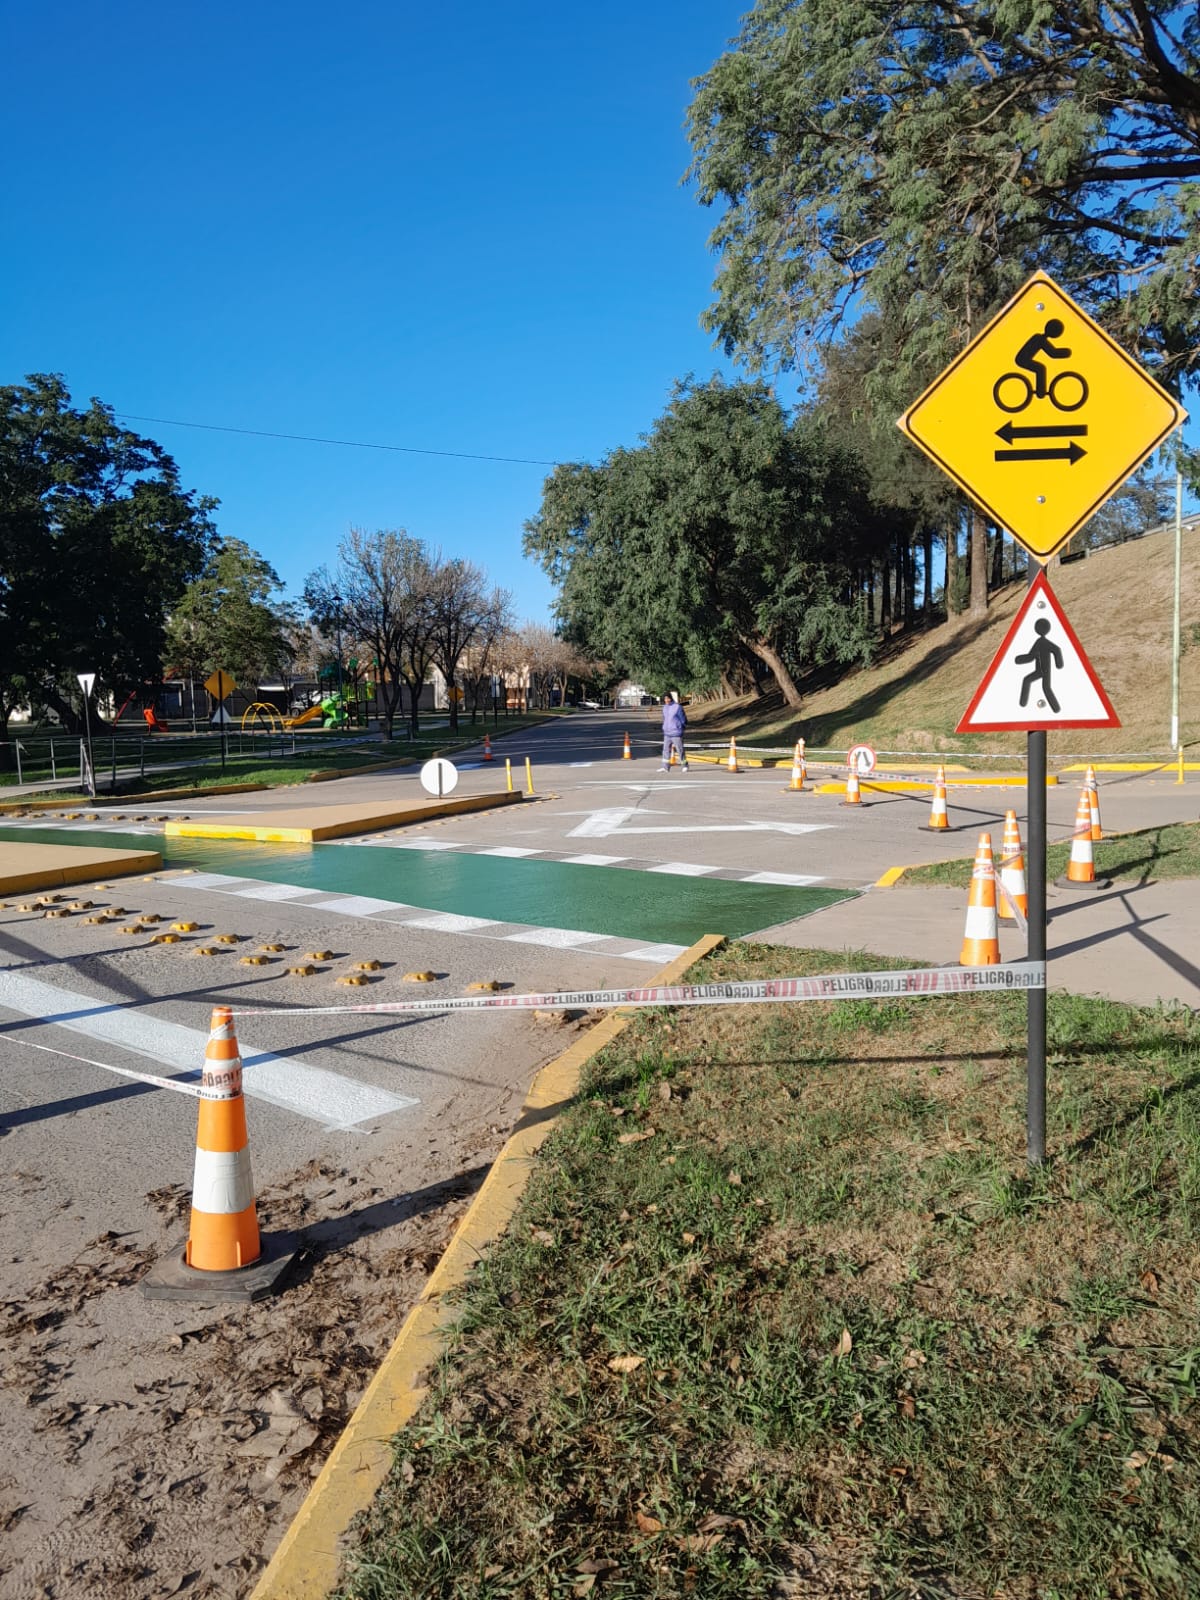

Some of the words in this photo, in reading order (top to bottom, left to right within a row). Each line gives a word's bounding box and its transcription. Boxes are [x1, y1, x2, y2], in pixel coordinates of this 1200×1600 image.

[682, 984, 733, 998] PELIGRO
[822, 977, 873, 992] PELIGRO
[963, 970, 1013, 985] PELIGRO
